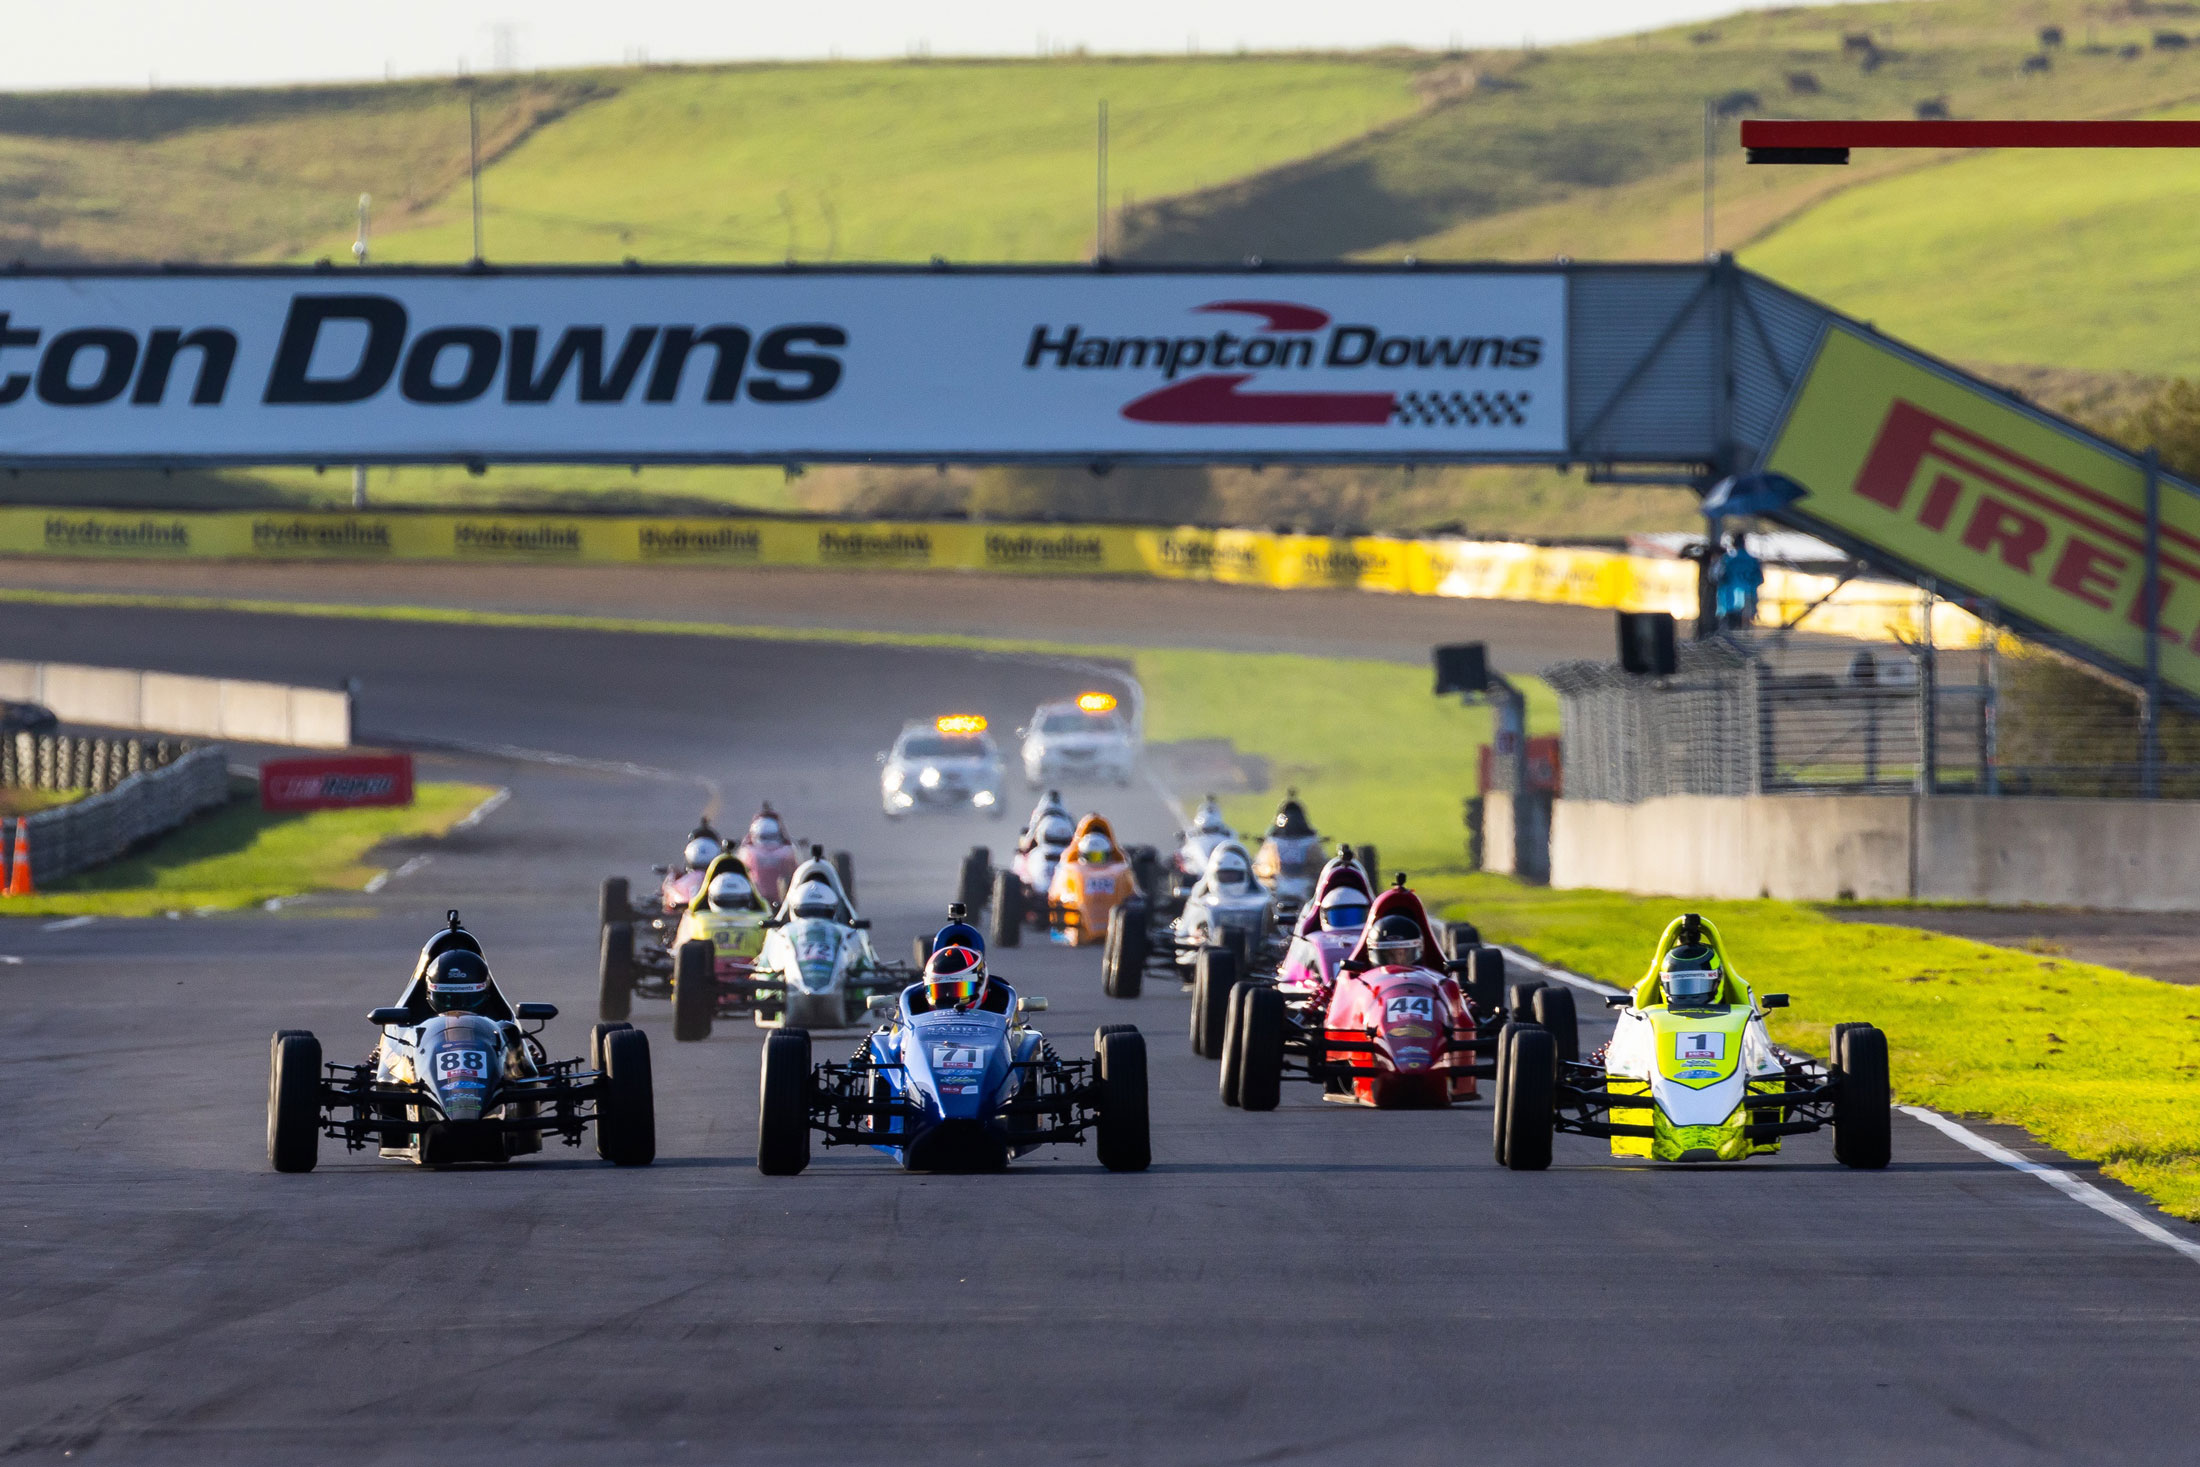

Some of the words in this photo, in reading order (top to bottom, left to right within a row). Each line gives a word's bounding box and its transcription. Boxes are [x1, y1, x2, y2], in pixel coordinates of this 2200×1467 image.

[261, 292, 849, 406] Downs
[1023, 325, 1313, 380] Hampton
[1324, 326, 1543, 370] Downs
[1853, 397, 2200, 658] PIREL
[1389, 997, 1430, 1015] 44
[1687, 1034, 1706, 1049] 1
[440, 1052, 483, 1070] 88
[938, 1049, 976, 1062] 71
